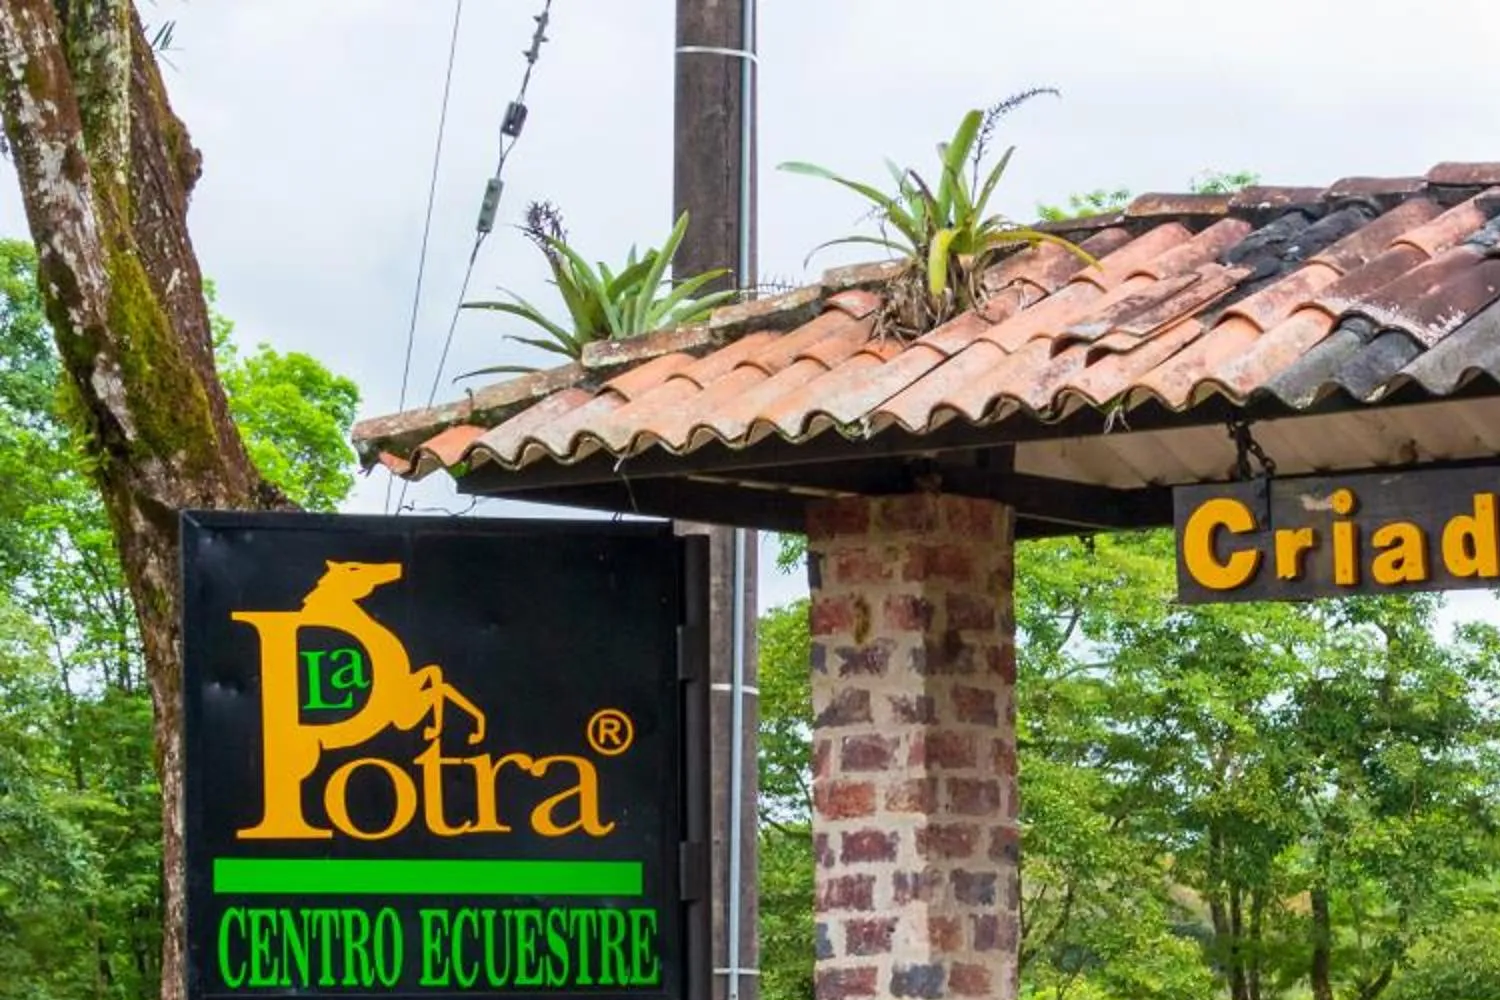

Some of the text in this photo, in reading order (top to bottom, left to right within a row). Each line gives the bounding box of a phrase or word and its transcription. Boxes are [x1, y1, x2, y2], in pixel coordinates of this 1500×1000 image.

[300, 647, 370, 709] La
[232, 611, 615, 842] Potra
[217, 906, 660, 988] CENTRO ECUESTRE
